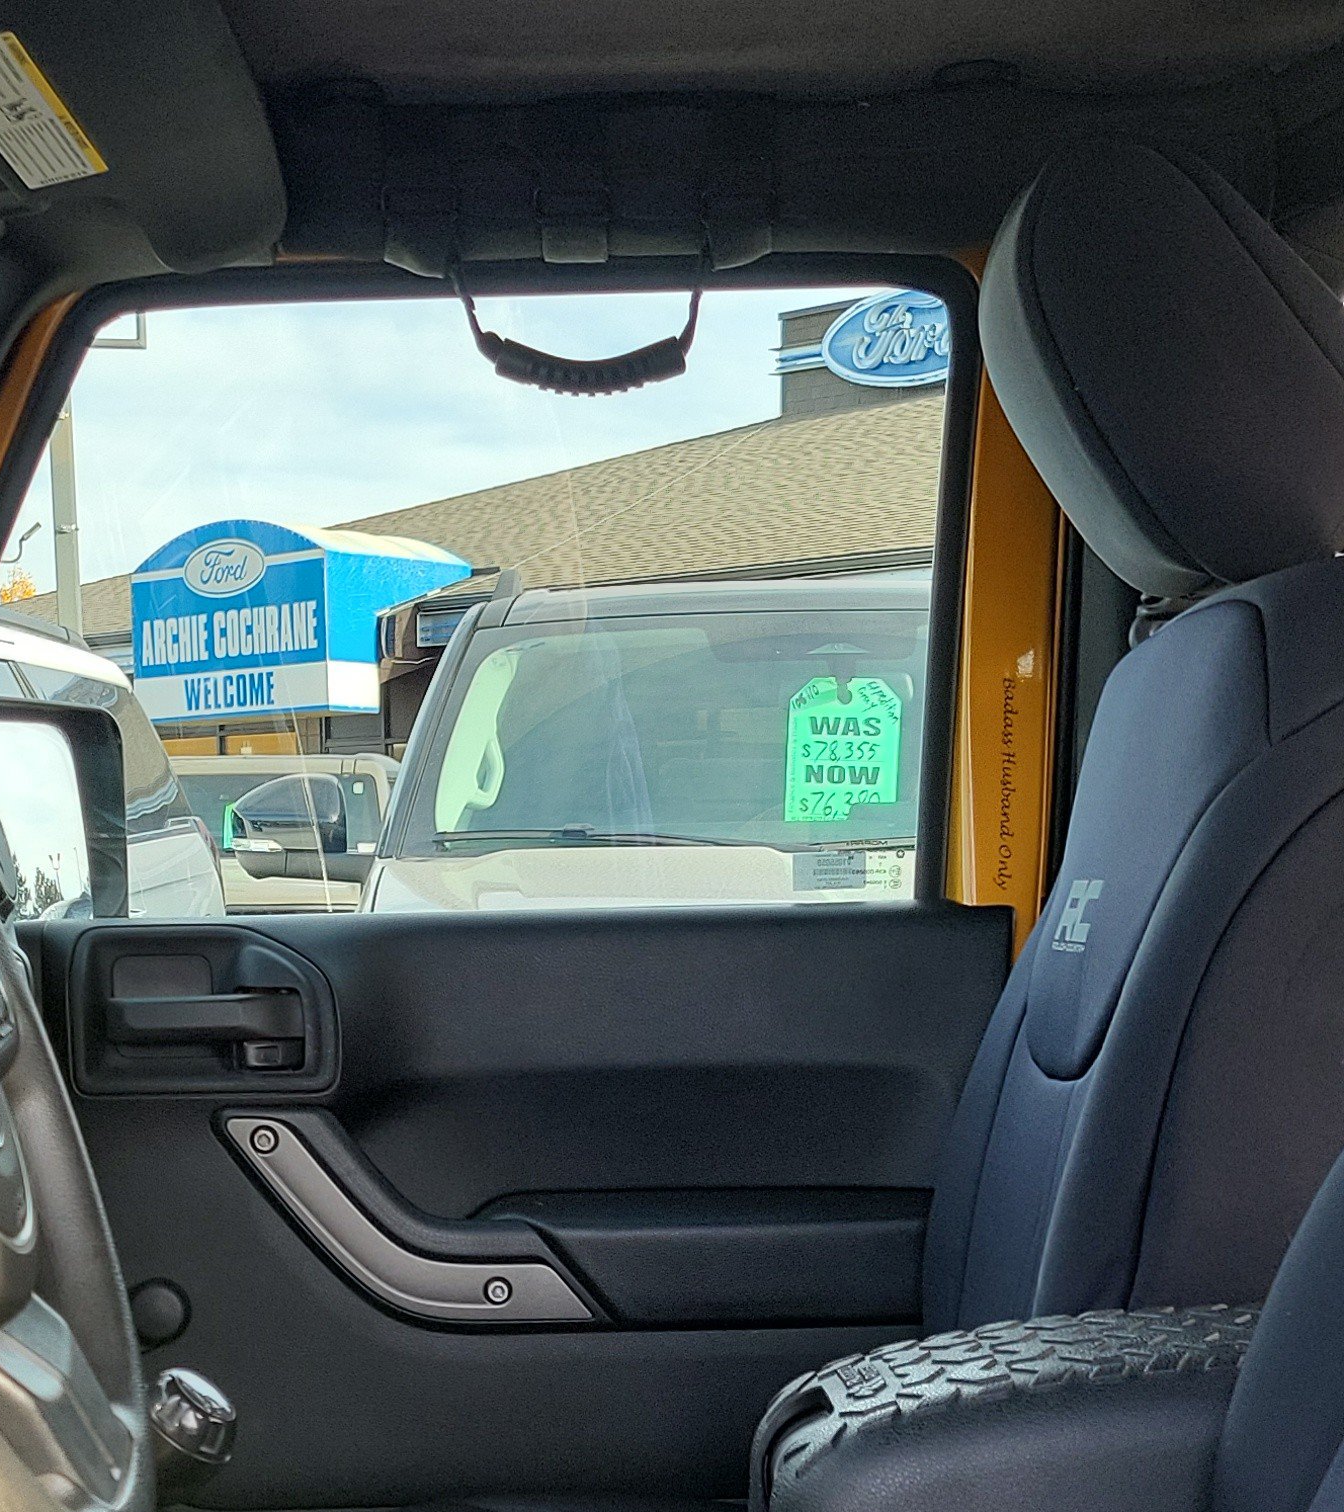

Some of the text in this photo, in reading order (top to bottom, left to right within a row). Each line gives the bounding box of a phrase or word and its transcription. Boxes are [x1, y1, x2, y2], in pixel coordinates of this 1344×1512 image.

[199, 549, 248, 585] Ford
[142, 600, 318, 666] ARCHIE COCHRANE
[184, 671, 274, 711] WELCOME
[809, 716, 882, 736] WAS
[805, 765, 881, 785] NOW
[993, 677, 1019, 891] Badass Husband Only
[1054, 880, 1104, 943] RC
